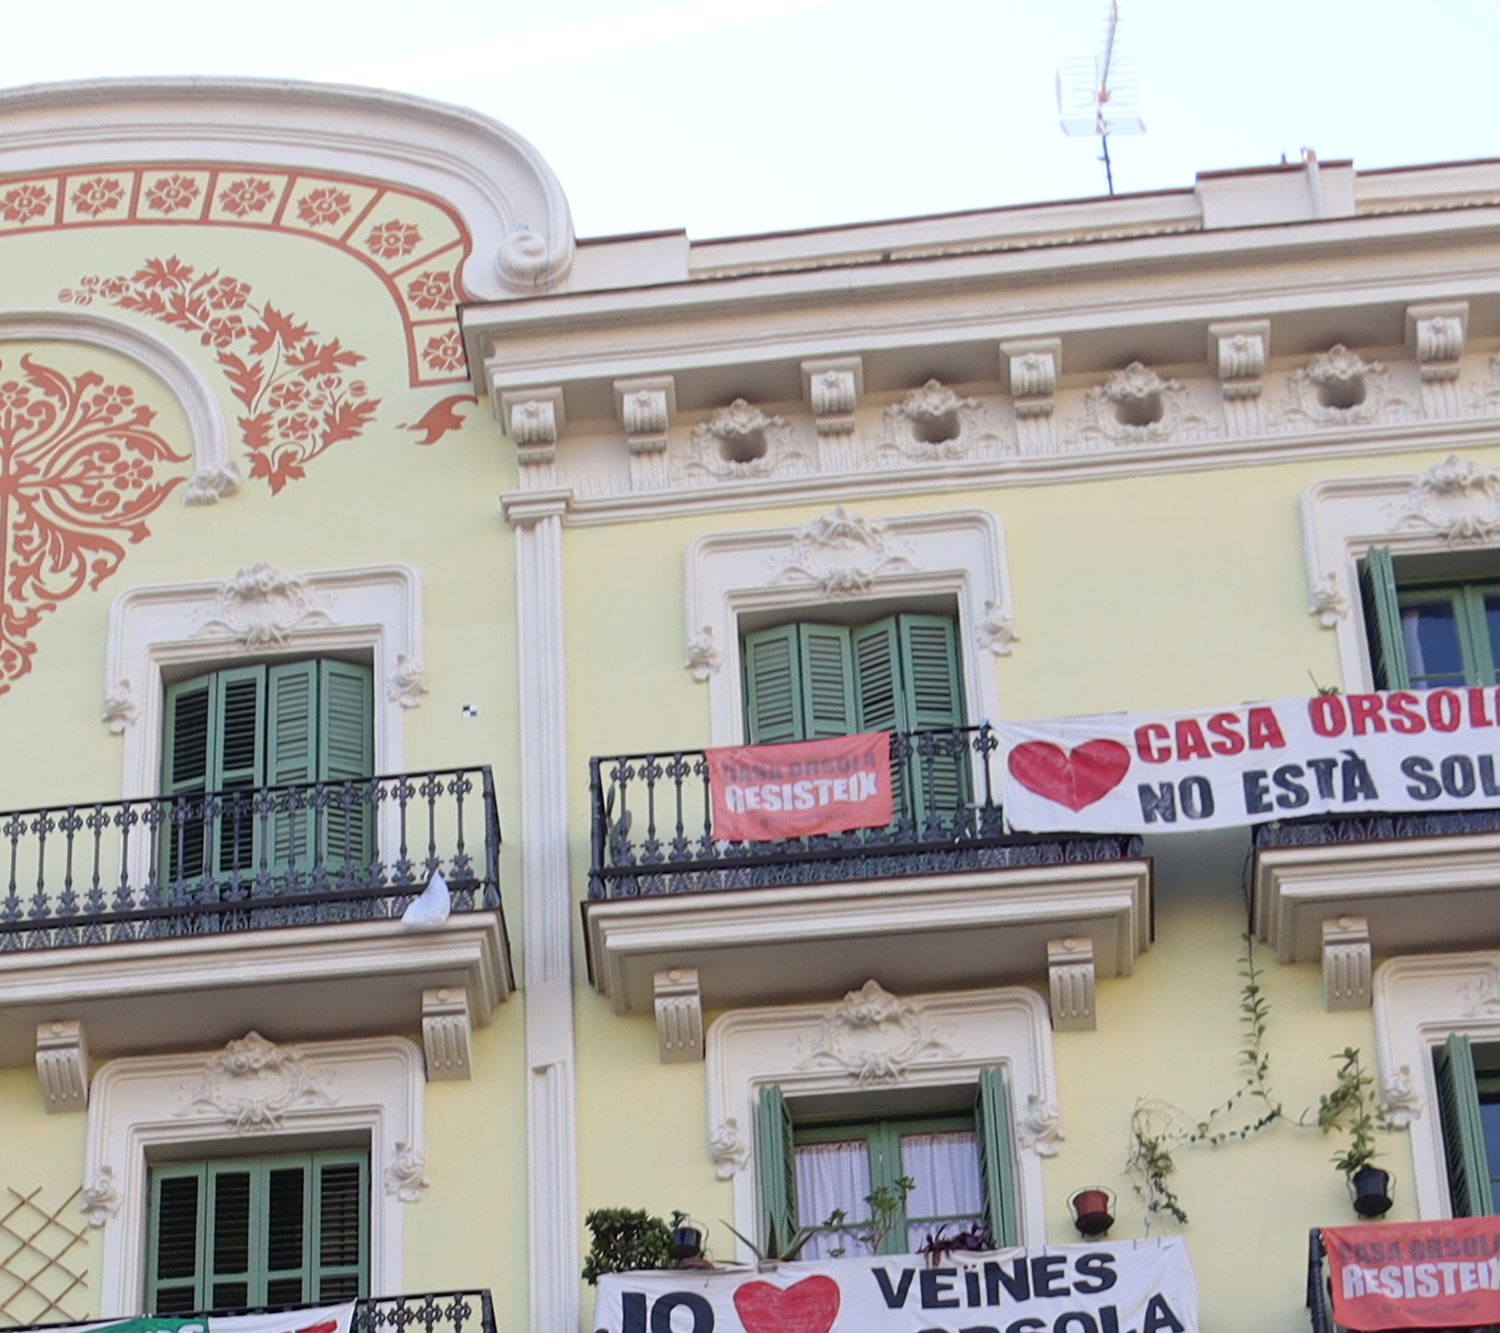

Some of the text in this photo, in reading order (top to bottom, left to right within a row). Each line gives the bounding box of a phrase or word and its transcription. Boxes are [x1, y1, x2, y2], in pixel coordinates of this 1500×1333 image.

[1133, 707, 1286, 764] CASA
[725, 771, 878, 814] RESISTEIX
[789, 752, 877, 778] ORSOLA
[1137, 773, 1216, 825] NO
[1242, 750, 1379, 815] ESTÀ
[871, 1252, 1117, 1309] VEÏNES
